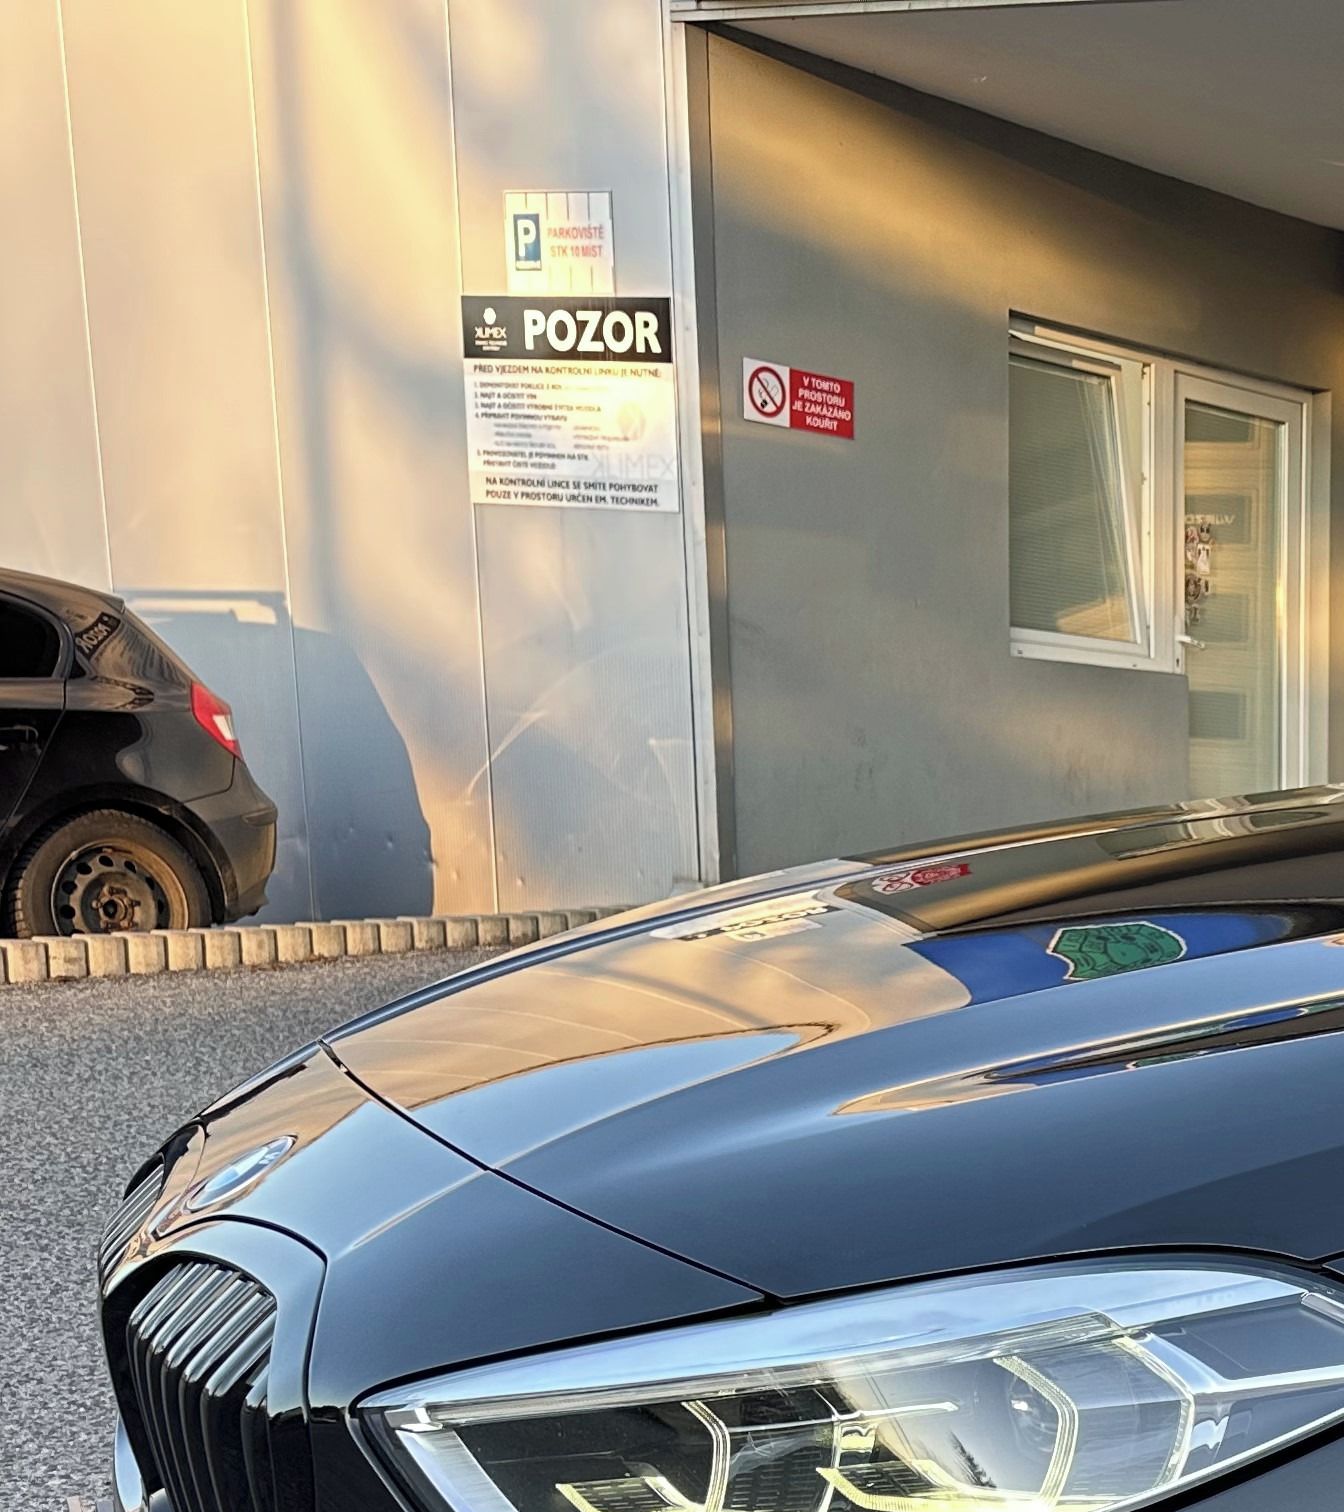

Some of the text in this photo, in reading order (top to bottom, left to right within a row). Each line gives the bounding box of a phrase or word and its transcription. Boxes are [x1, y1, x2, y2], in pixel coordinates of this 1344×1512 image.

[517, 219, 537, 257] P
[547, 224, 604, 240] PARKOVIŠTĚ
[550, 245, 568, 258] STK
[571, 245, 580, 257] 10
[523, 309, 662, 354] POZOR
[495, 365, 529, 375] VJEZDEM
[531, 366, 543, 374] NA
[802, 376, 841, 394] V TOMTO
[798, 388, 846, 408] PROSTORU
[792, 400, 852, 422] JE ZAKÁZÁNO
[806, 415, 838, 431] KOUŘIT
[486, 477, 497, 485] NA
[499, 477, 545, 487] KONTROLNÍ
[547, 480, 570, 489] LINCE
[572, 481, 582, 489] SE
[609, 482, 658, 493] POHYBOVAT
[486, 490, 511, 499] POUZE
[513, 491, 519, 499] V
[521, 491, 564, 501] PROSTORU
